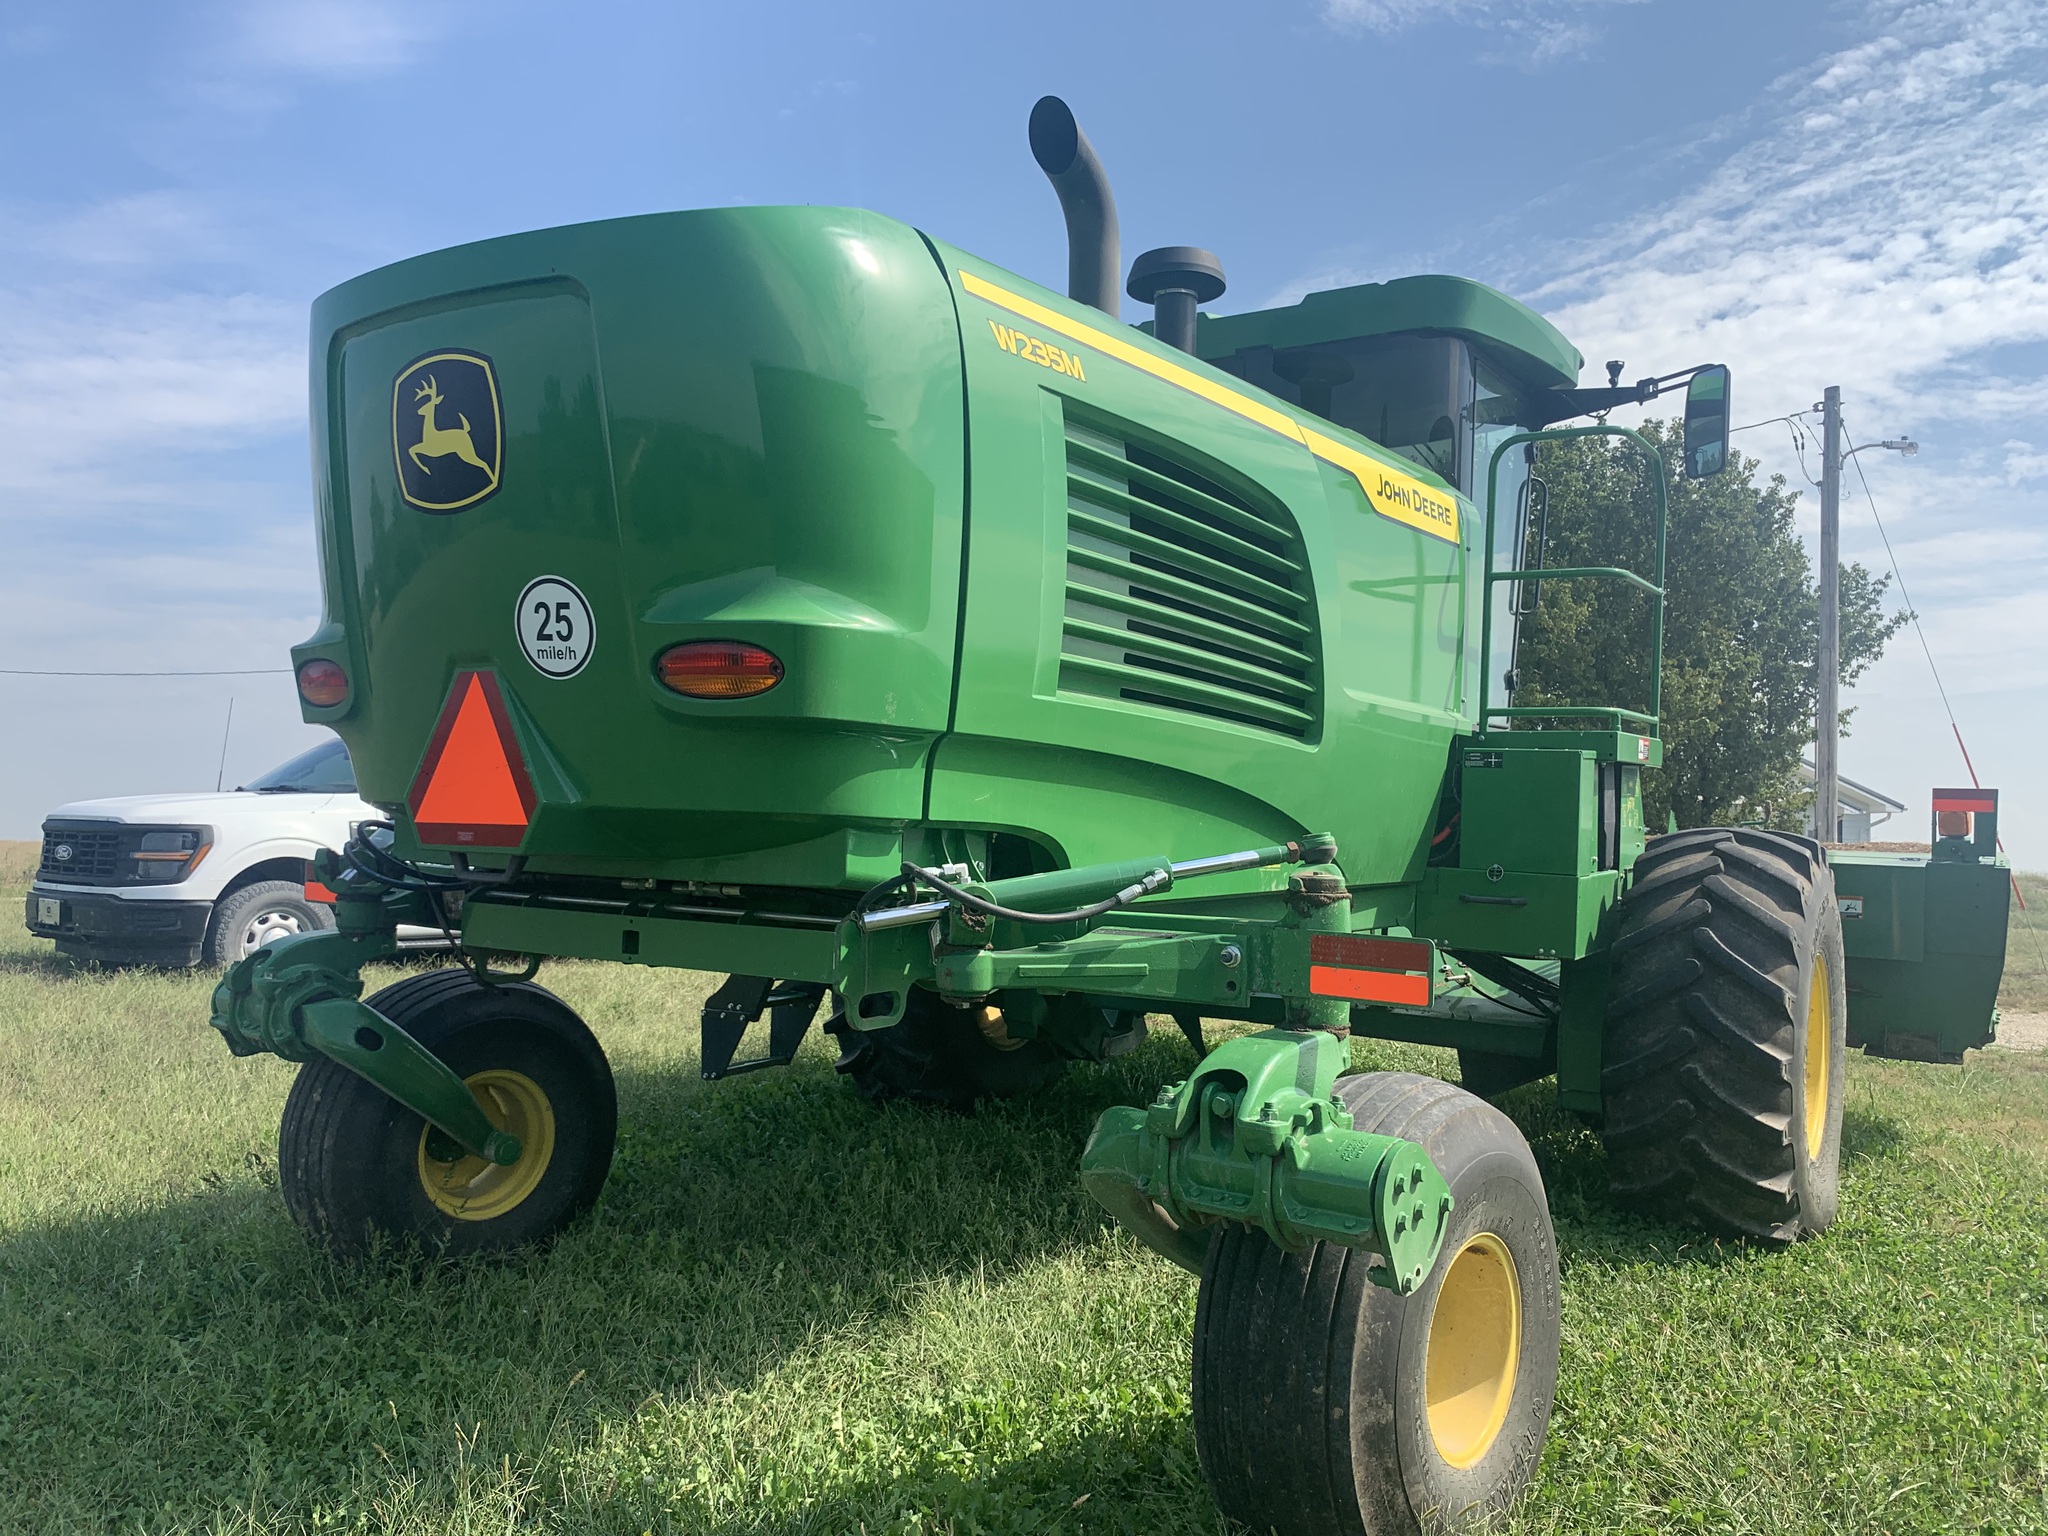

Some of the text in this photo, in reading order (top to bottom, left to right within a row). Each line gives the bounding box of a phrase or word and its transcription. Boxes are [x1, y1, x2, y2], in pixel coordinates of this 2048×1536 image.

[987, 318, 1087, 383] W235M
[1377, 473, 1452, 527] JOHN DEERE
[534, 601, 574, 643] 25
[537, 646, 577, 660] mile/h
